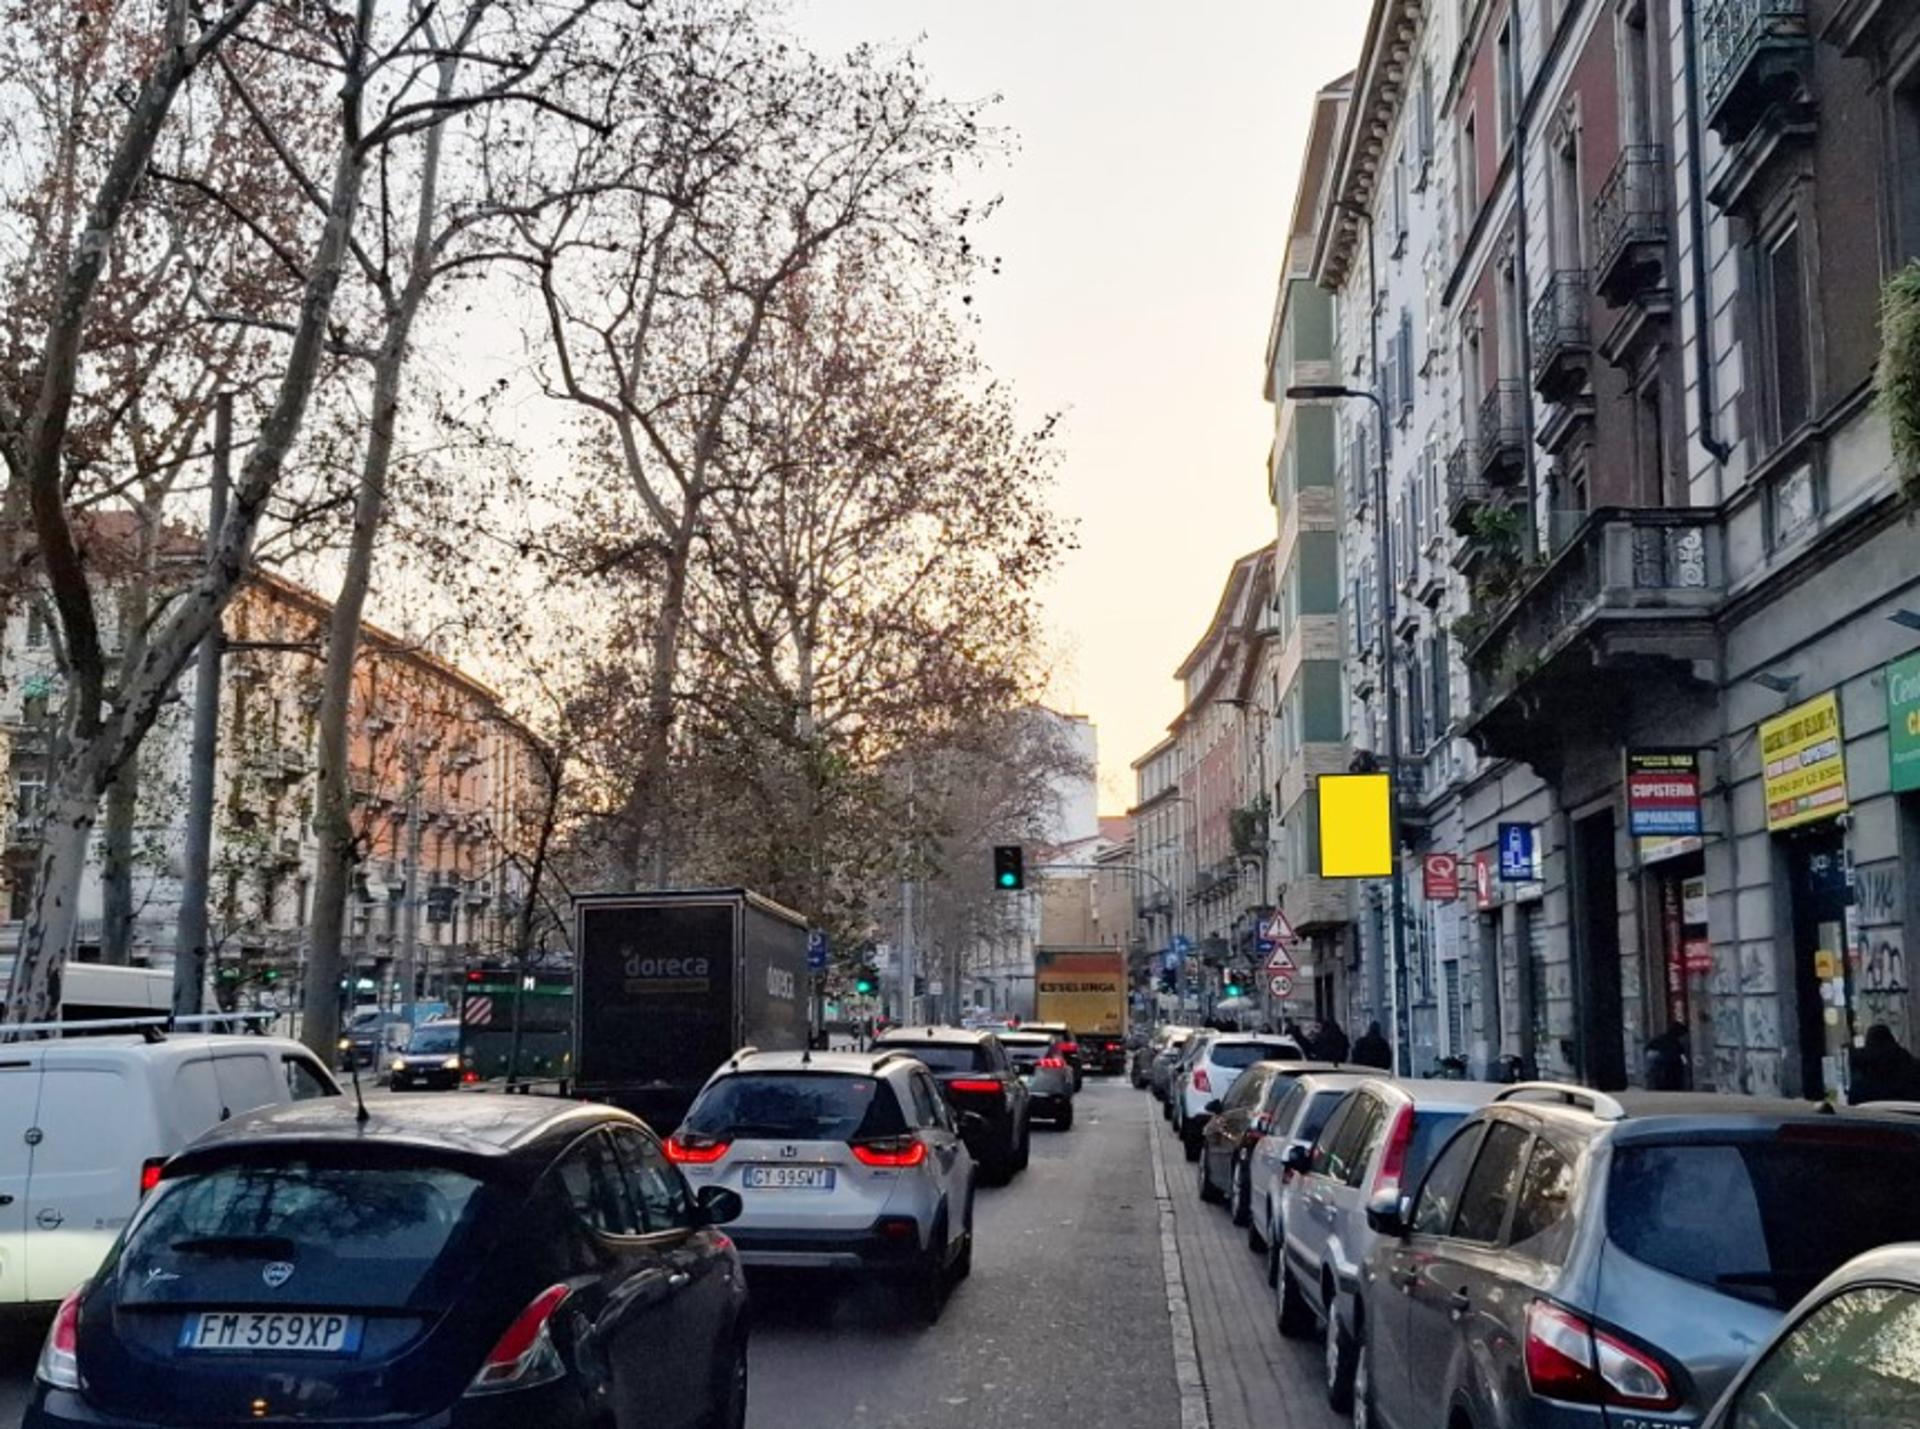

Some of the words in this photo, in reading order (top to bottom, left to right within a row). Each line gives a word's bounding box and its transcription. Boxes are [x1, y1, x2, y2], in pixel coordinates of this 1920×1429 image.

[1631, 782, 1696, 797] COPISTERIA
[625, 952, 709, 977] doreca
[200, 1314, 240, 1345] FM
[246, 1315, 342, 1347] 369XP
